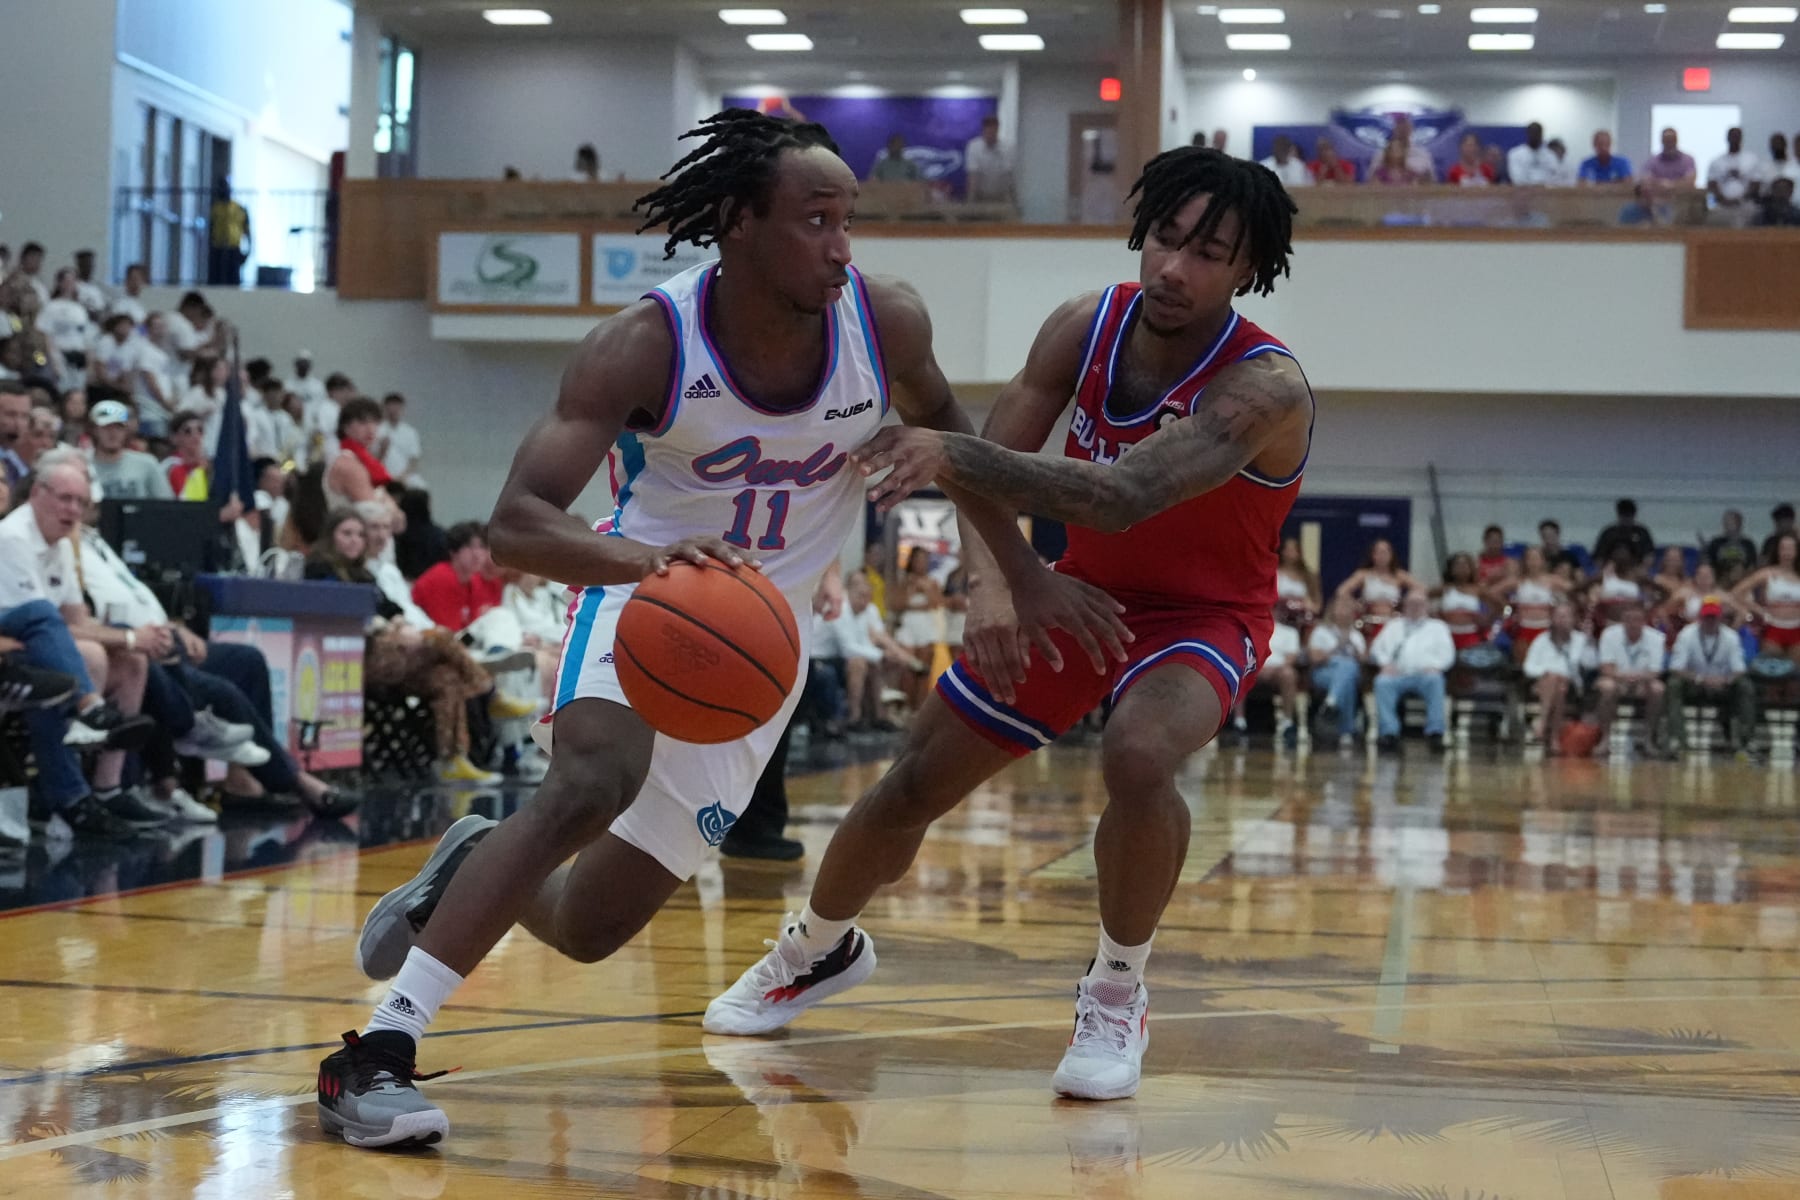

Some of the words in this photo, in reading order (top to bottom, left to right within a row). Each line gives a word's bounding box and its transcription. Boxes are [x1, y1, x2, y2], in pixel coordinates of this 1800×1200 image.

[684, 390, 721, 399] adidas
[691, 435, 848, 487] Owls
[722, 488, 790, 550] 11
[389, 1000, 416, 1016] adidas
